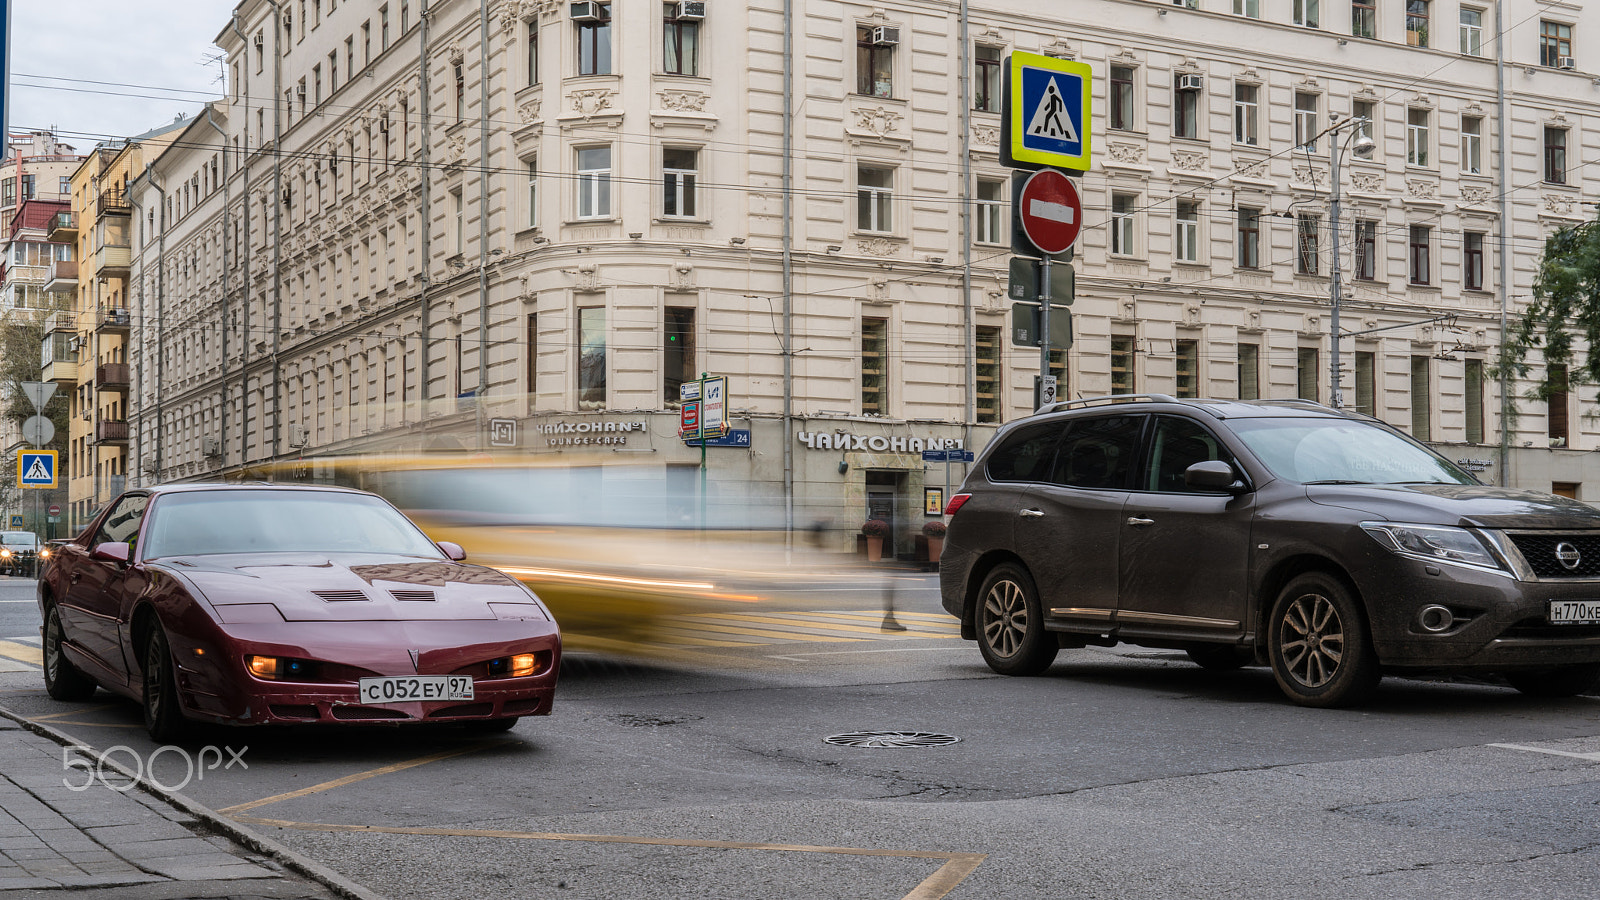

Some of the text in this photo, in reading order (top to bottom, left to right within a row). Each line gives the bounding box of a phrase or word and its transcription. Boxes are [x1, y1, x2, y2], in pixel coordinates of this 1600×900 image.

[536, 420, 615, 434] ЧАЙХОНА
[737, 434, 748, 443] 24
[797, 428, 923, 453] ЧАЙХОНА
[368, 679, 467, 699] С052ЕУ 97
